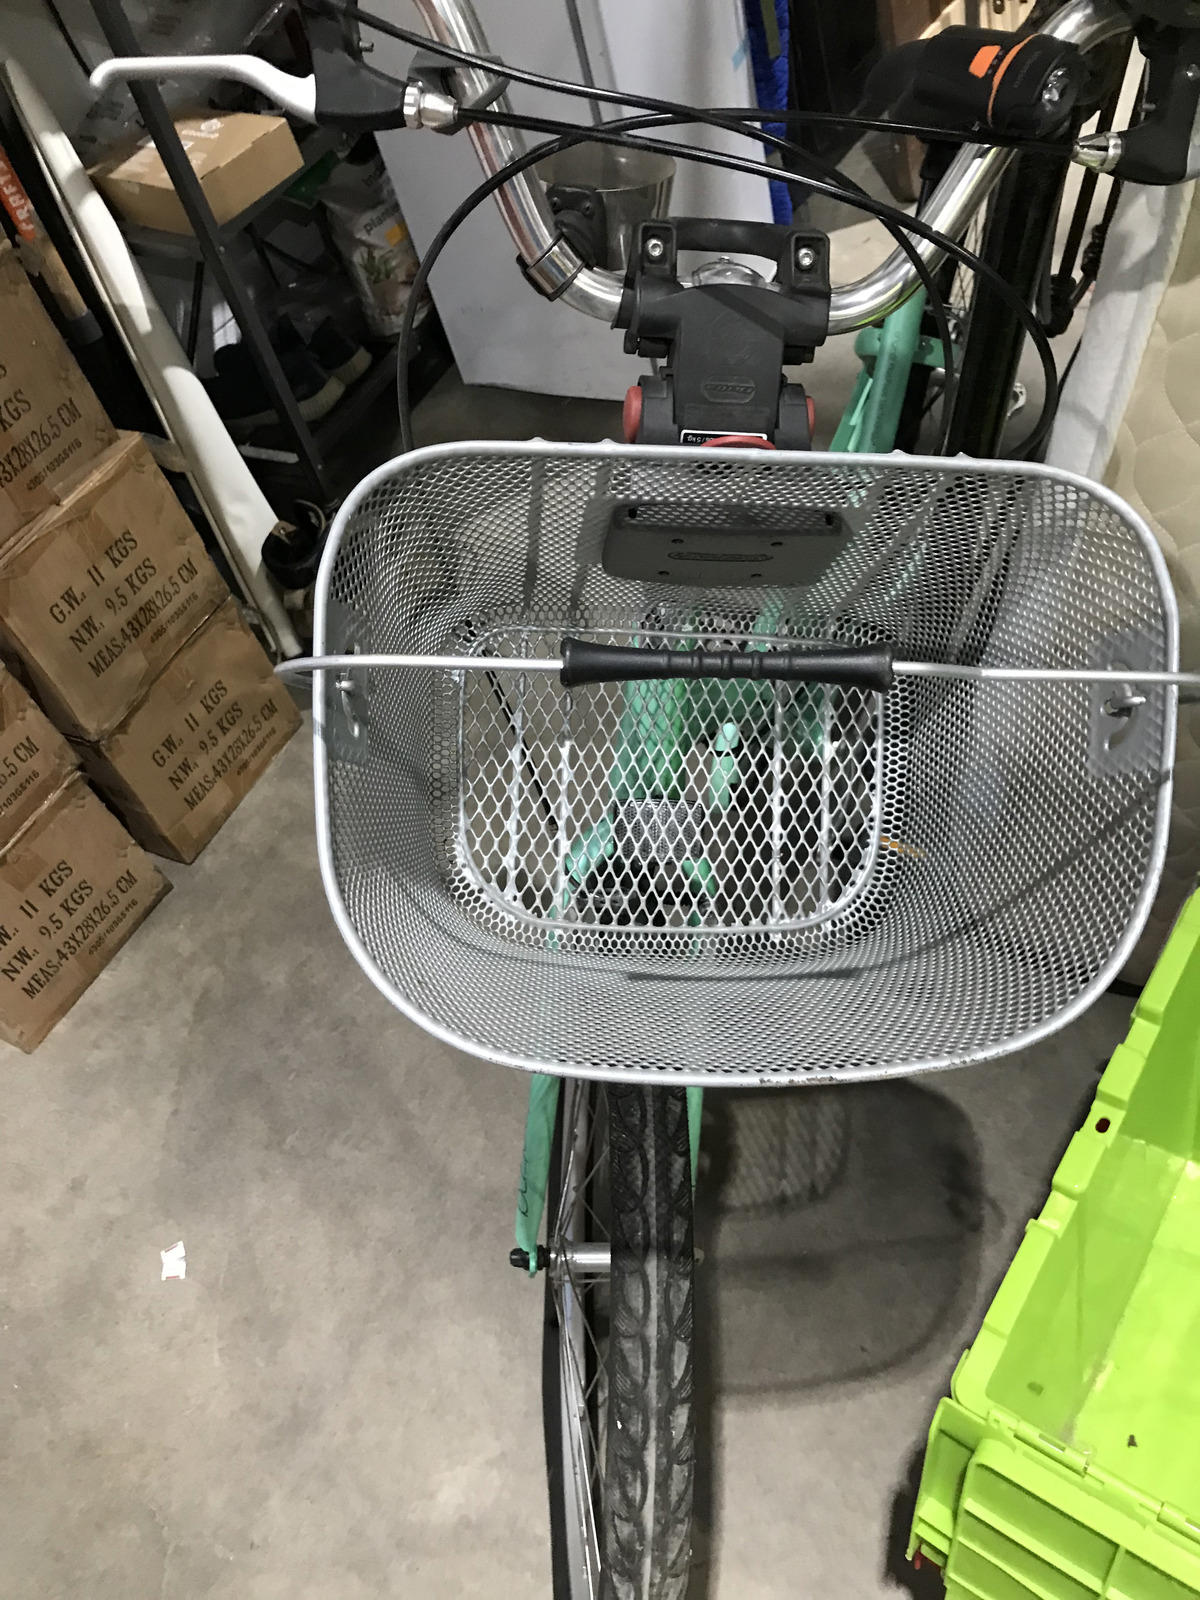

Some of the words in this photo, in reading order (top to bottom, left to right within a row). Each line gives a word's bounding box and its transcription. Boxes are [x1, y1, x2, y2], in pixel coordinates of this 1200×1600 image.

[56, 396, 82, 428] CM
[86, 563, 106, 588] 11
[104, 528, 139, 569] KGS
[177, 556, 199, 584] CM
[104, 586, 129, 617] 9.5
[124, 556, 157, 596] KGS
[184, 712, 200, 733] 11
[199, 679, 229, 715] KGS
[199, 728, 220, 756] 9.5
[215, 701, 244, 737] KGS
[260, 698, 279, 722] CM
[13, 735, 40, 763] CM
[20, 899, 40, 920] 11
[38, 859, 74, 898] KGS
[115, 868, 139, 895] CM
[39, 912, 64, 940] 9.5
[59, 879, 94, 918] KGS
